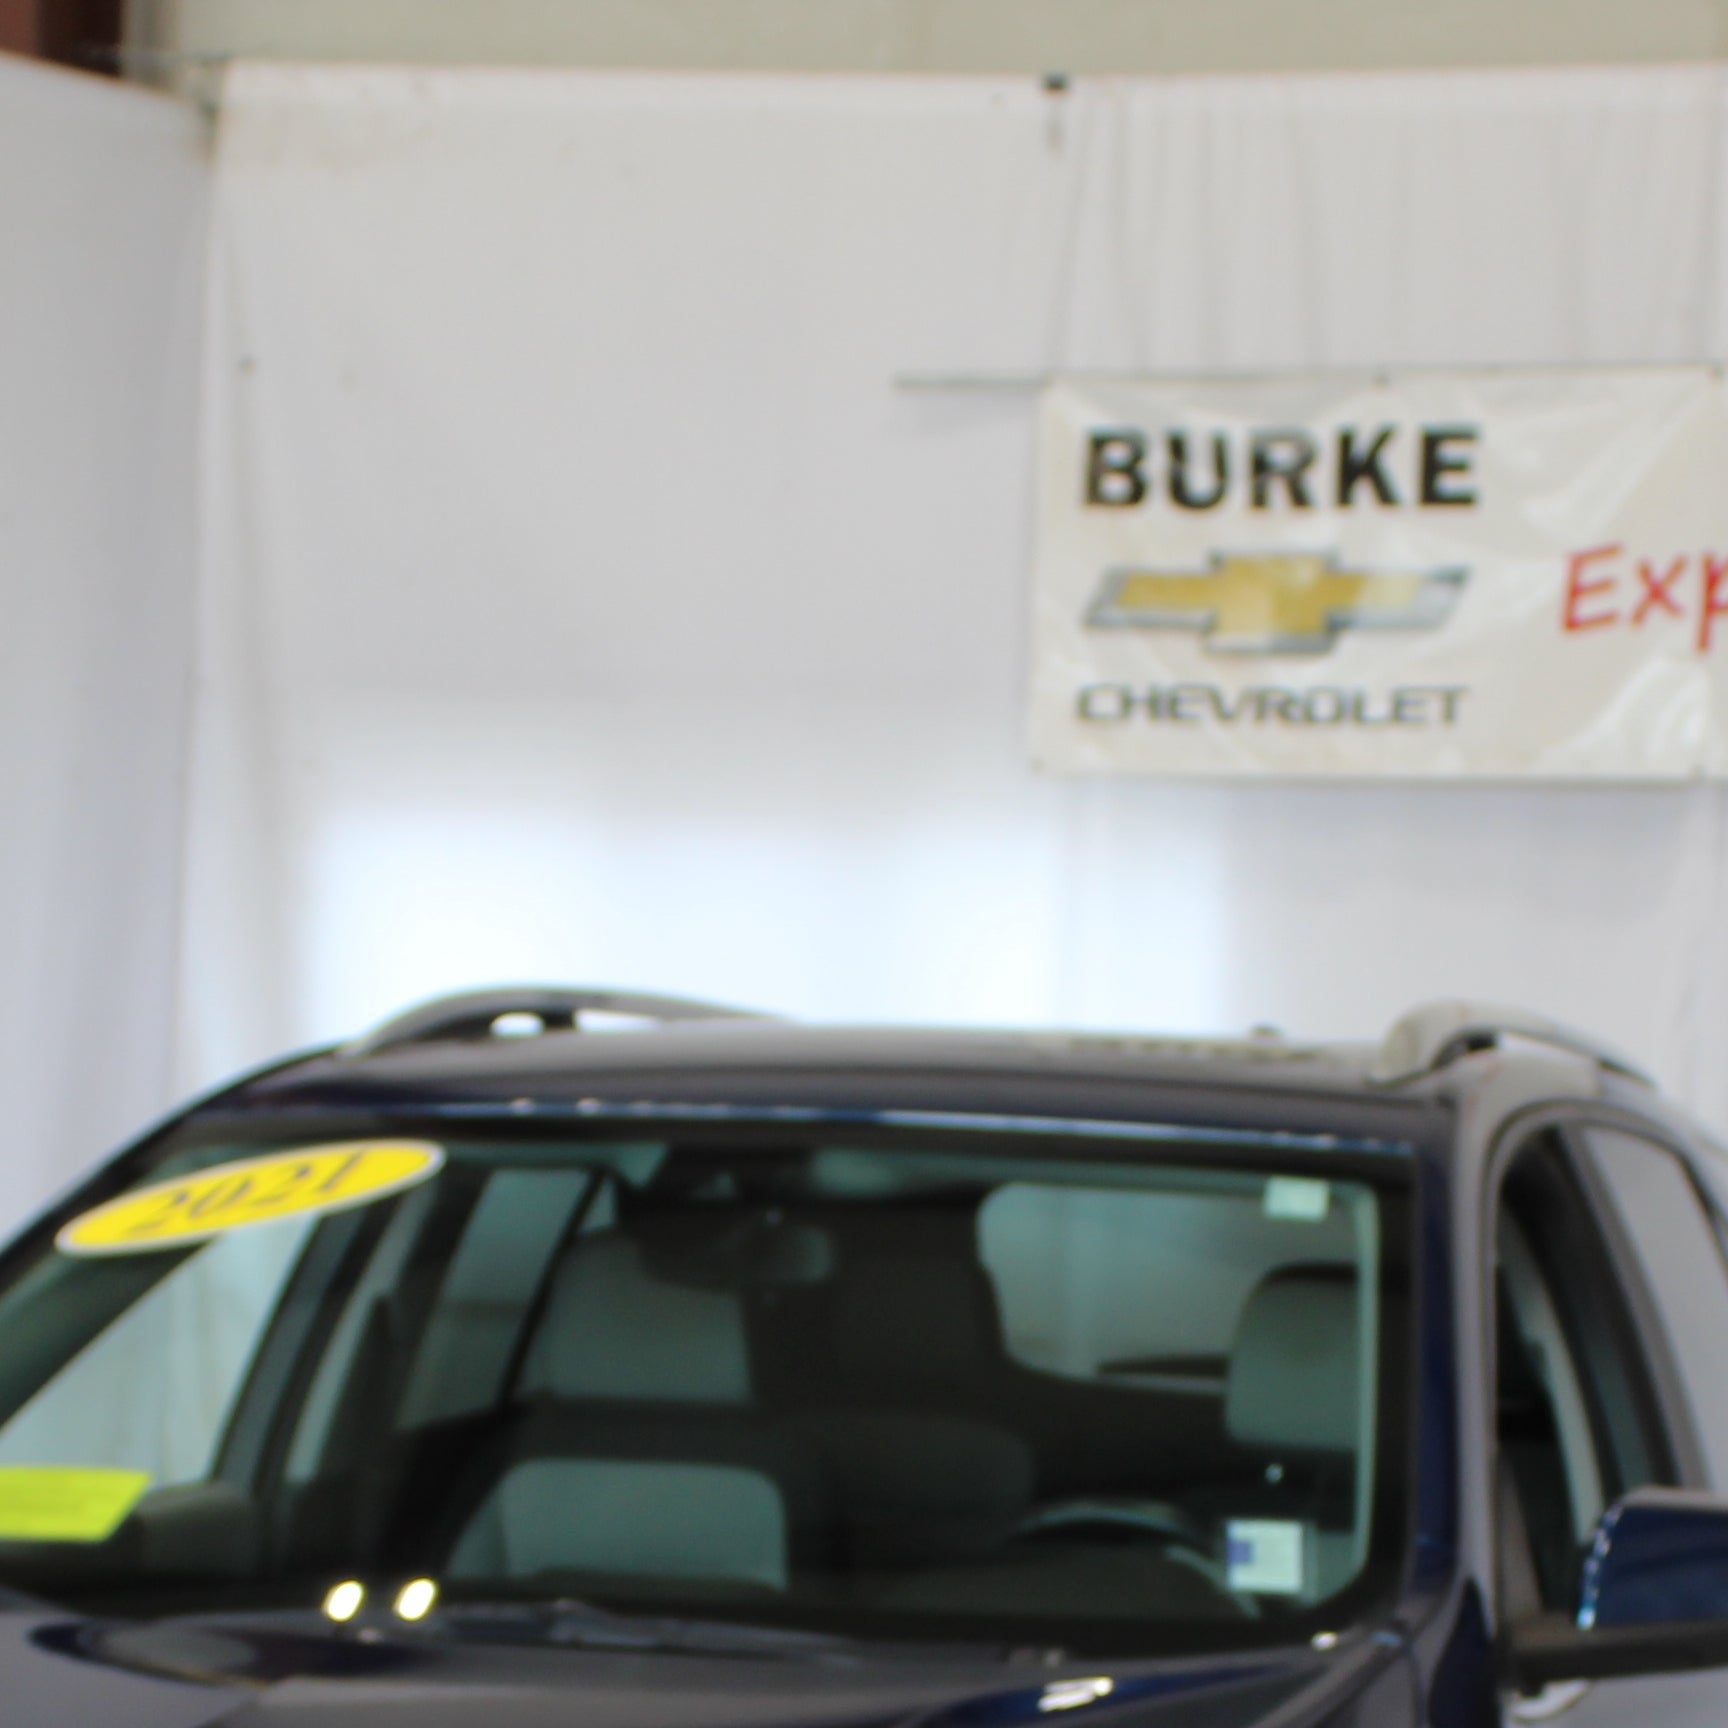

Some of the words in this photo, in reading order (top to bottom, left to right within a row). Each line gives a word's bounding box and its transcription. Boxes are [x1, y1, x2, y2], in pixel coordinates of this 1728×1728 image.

[1083, 424, 1479, 510] BURKE
[1076, 682, 1468, 725] CHEVROLET
[125, 1150, 366, 1237] 2021
